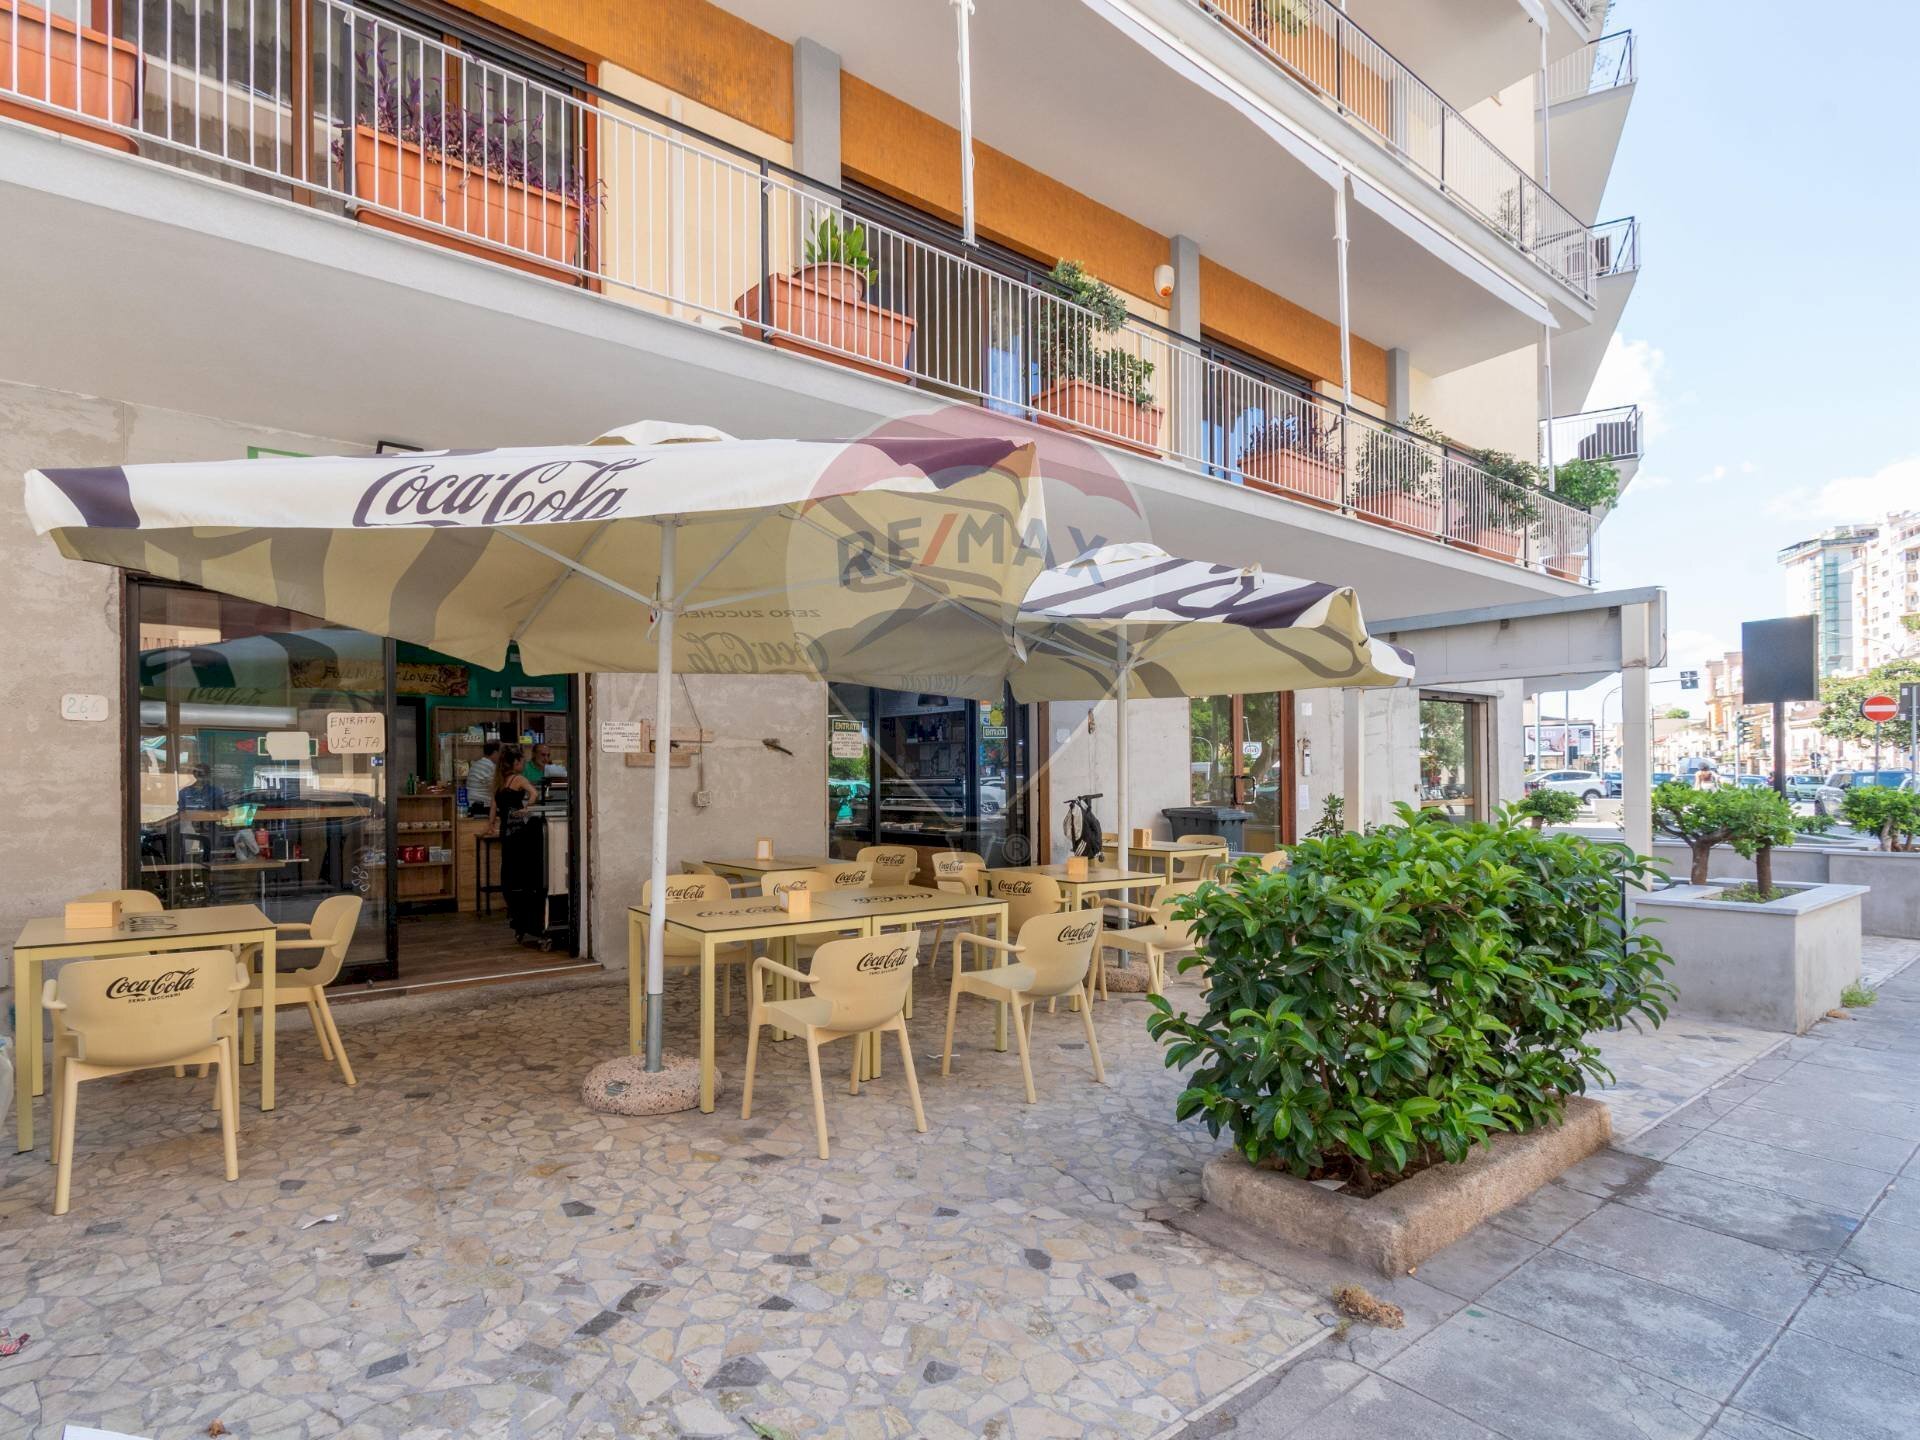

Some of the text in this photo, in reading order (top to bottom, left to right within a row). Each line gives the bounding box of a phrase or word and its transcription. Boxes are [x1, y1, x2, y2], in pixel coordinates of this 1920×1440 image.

[352, 457, 656, 527] Coca-Cola
[330, 716, 377, 728] ENTRATA
[344, 727, 351, 735] E
[330, 736, 380, 749] USCITA
[999, 880, 1032, 894] Coca-Cola
[1057, 921, 1098, 943] Coca-Cola
[856, 947, 910, 972] Coca-Cola
[106, 968, 200, 999] Coca-Cola
